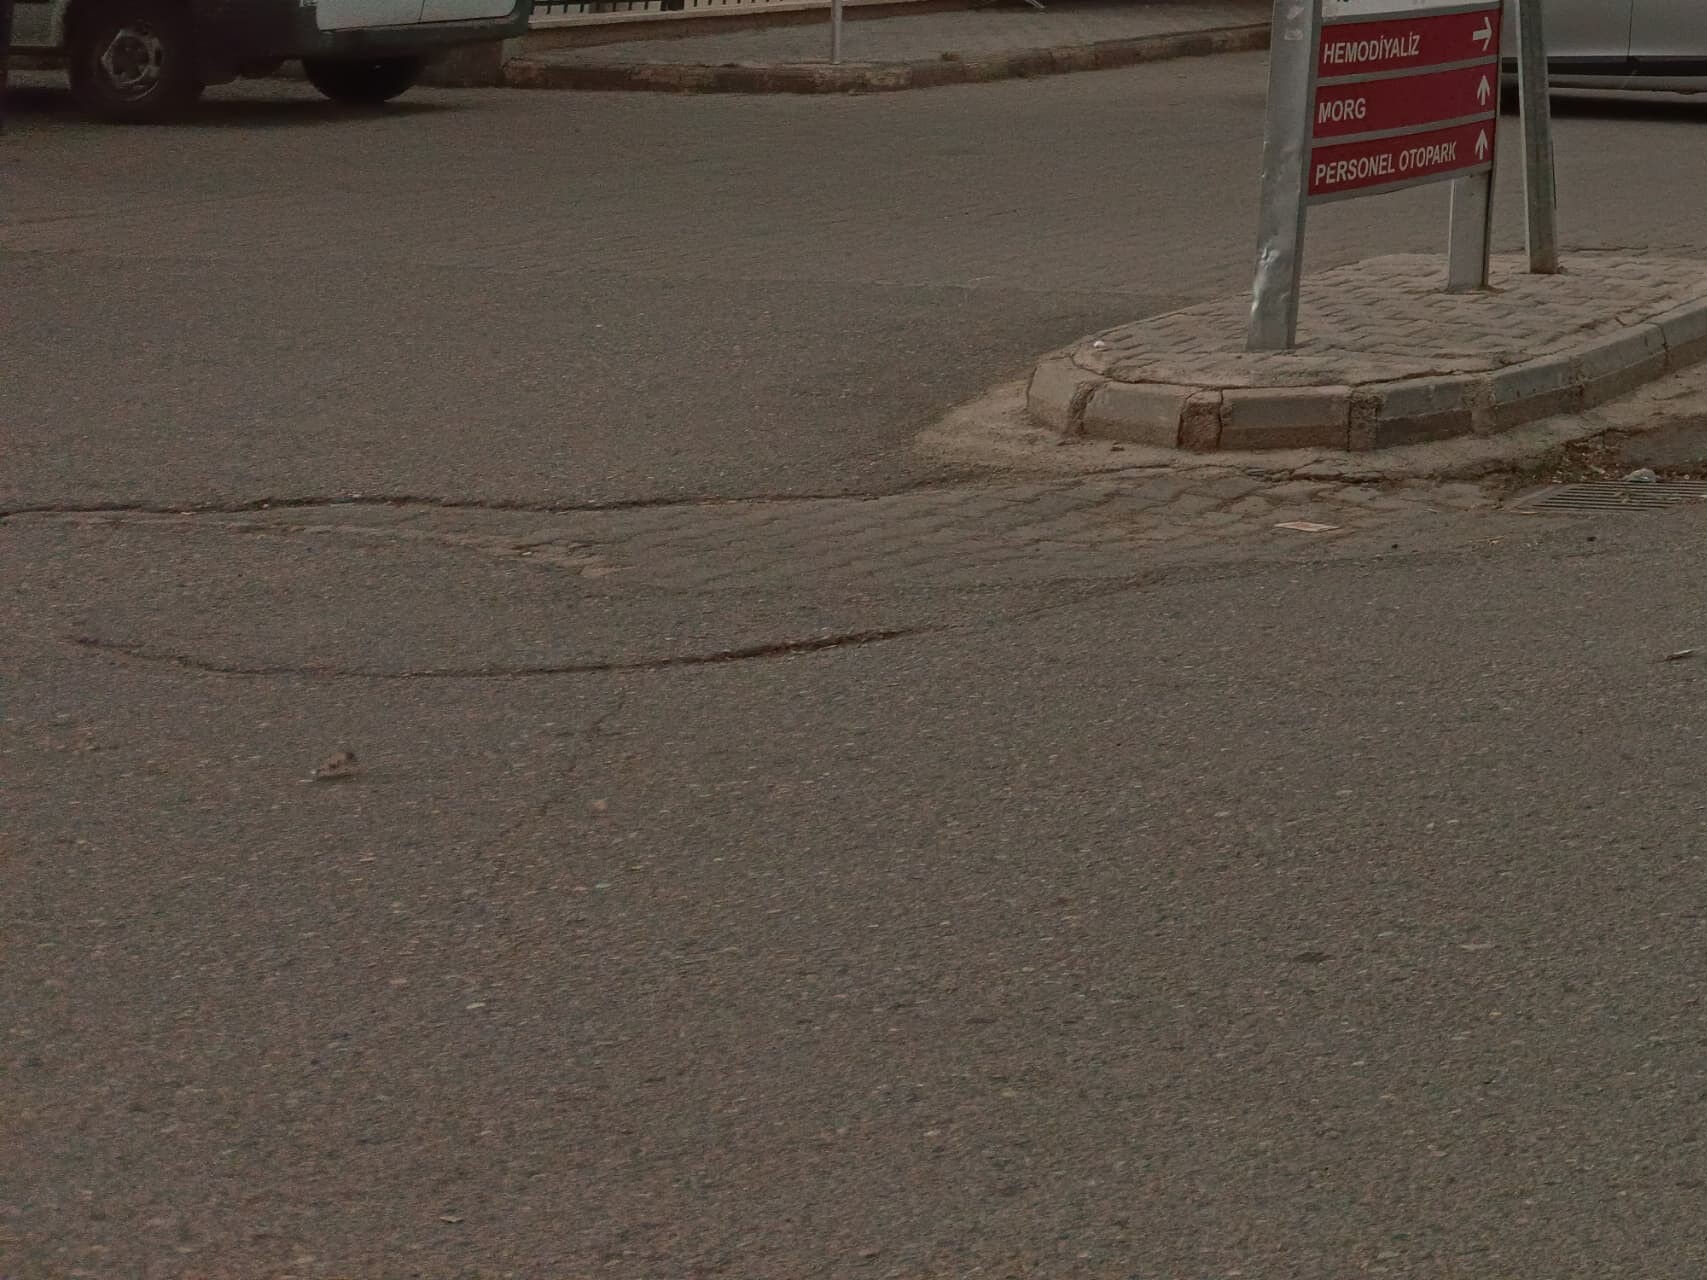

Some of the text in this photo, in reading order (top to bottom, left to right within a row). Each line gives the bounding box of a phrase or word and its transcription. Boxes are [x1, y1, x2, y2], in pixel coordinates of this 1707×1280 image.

[1323, 31, 1420, 65] HEMODİYALİZ
[1318, 97, 1367, 124] MORG
[1314, 141, 1458, 187] PERSONEL OTOPARK
